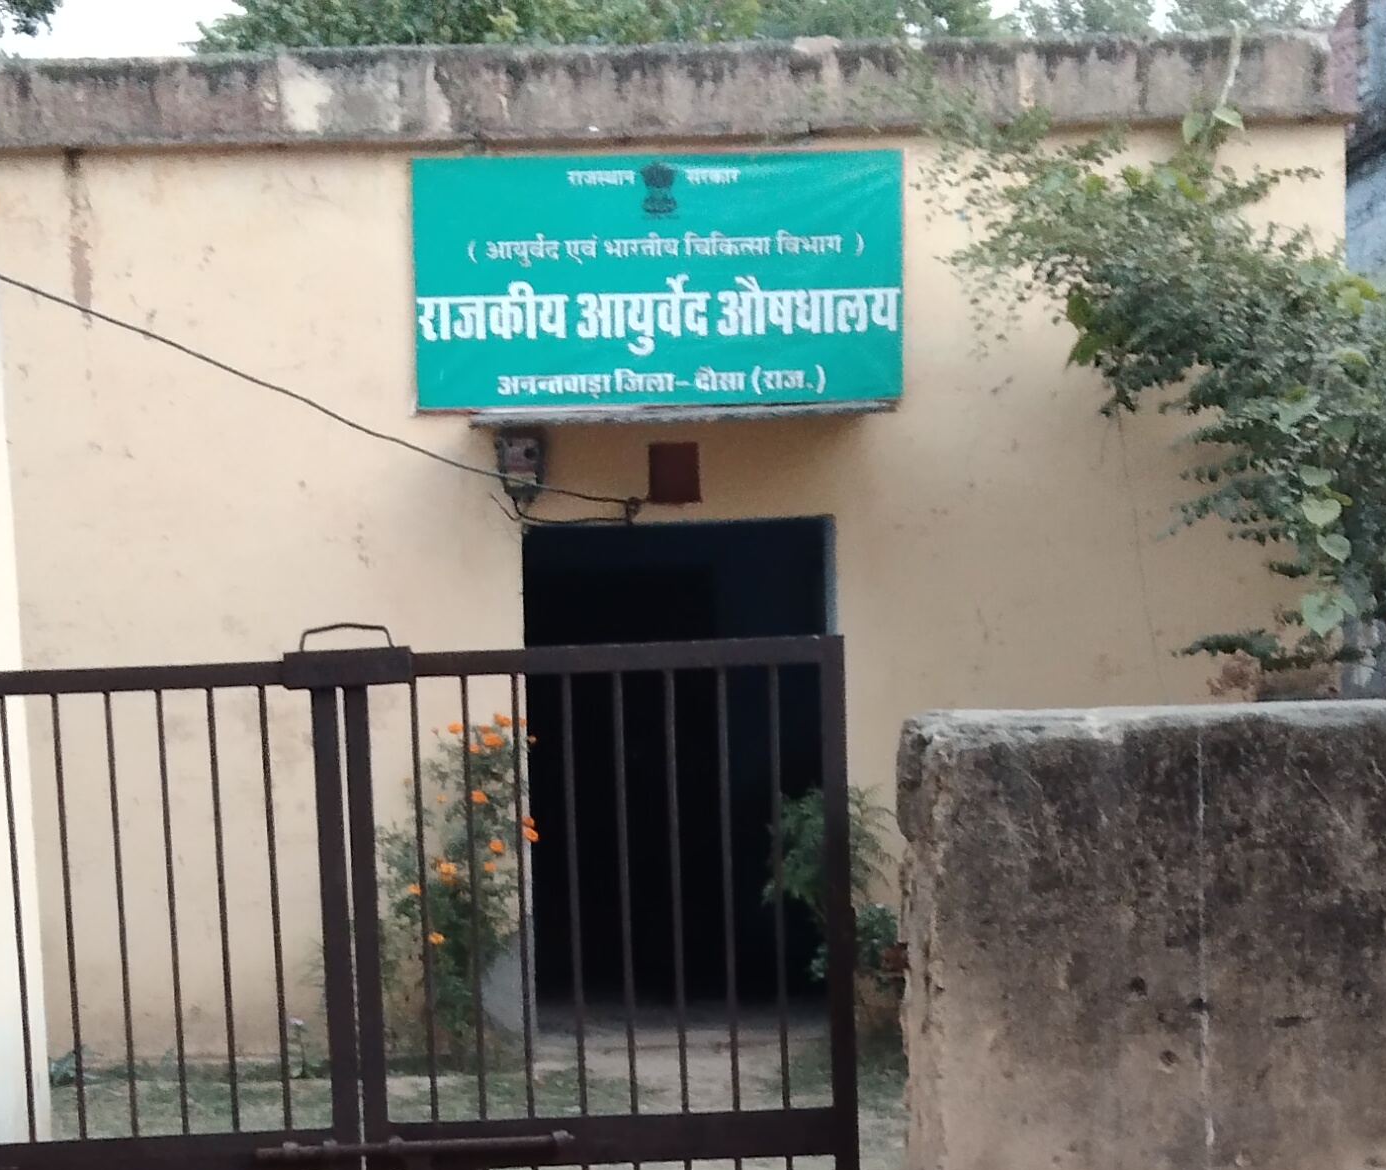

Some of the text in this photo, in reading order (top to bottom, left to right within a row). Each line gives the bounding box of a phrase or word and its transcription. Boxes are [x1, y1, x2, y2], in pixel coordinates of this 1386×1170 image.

[486, 232, 560, 268] आयुर्वेद
[564, 234, 598, 265] एवं
[604, 232, 679, 257] भारतीय
[684, 230, 771, 256] चिकित्सा
[776, 229, 842, 255] विभाग
[416, 273, 901, 356] राजकीय आयुर्वेद औषधालय
